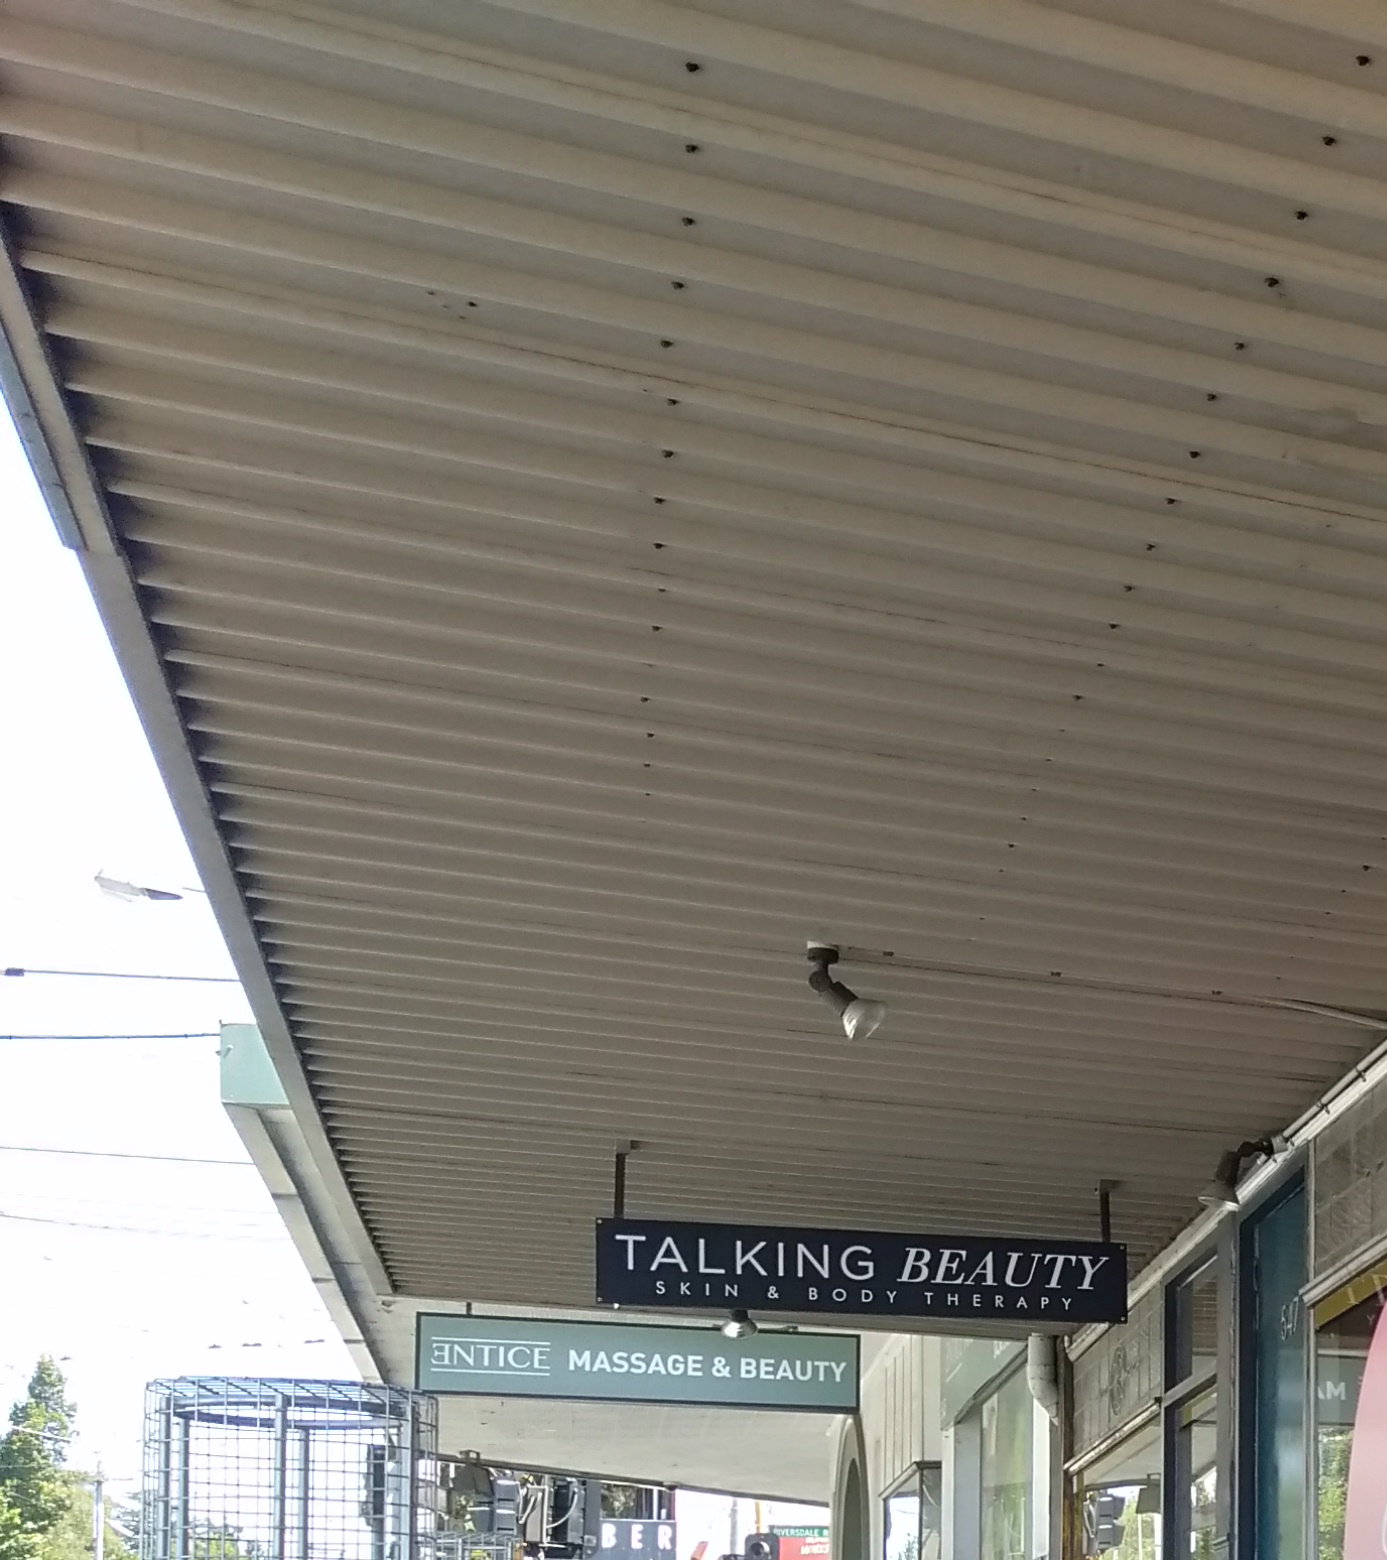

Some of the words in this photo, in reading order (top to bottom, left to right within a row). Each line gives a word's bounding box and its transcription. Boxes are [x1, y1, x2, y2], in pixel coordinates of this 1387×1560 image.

[615, 1235, 875, 1281] TALKING
[897, 1247, 1109, 1290] BEAUTY
[655, 1281, 739, 1297] SKIN
[767, 1286, 780, 1300] &
[809, 1288, 898, 1304] BODY
[924, 1292, 1072, 1311] THERAPY
[1280, 1294, 1300, 1341] 547
[431, 1343, 551, 1370] ENTICE
[568, 1349, 703, 1377] MASSAGE
[711, 1357, 731, 1378] &
[739, 1357, 848, 1383] BEAUTY
